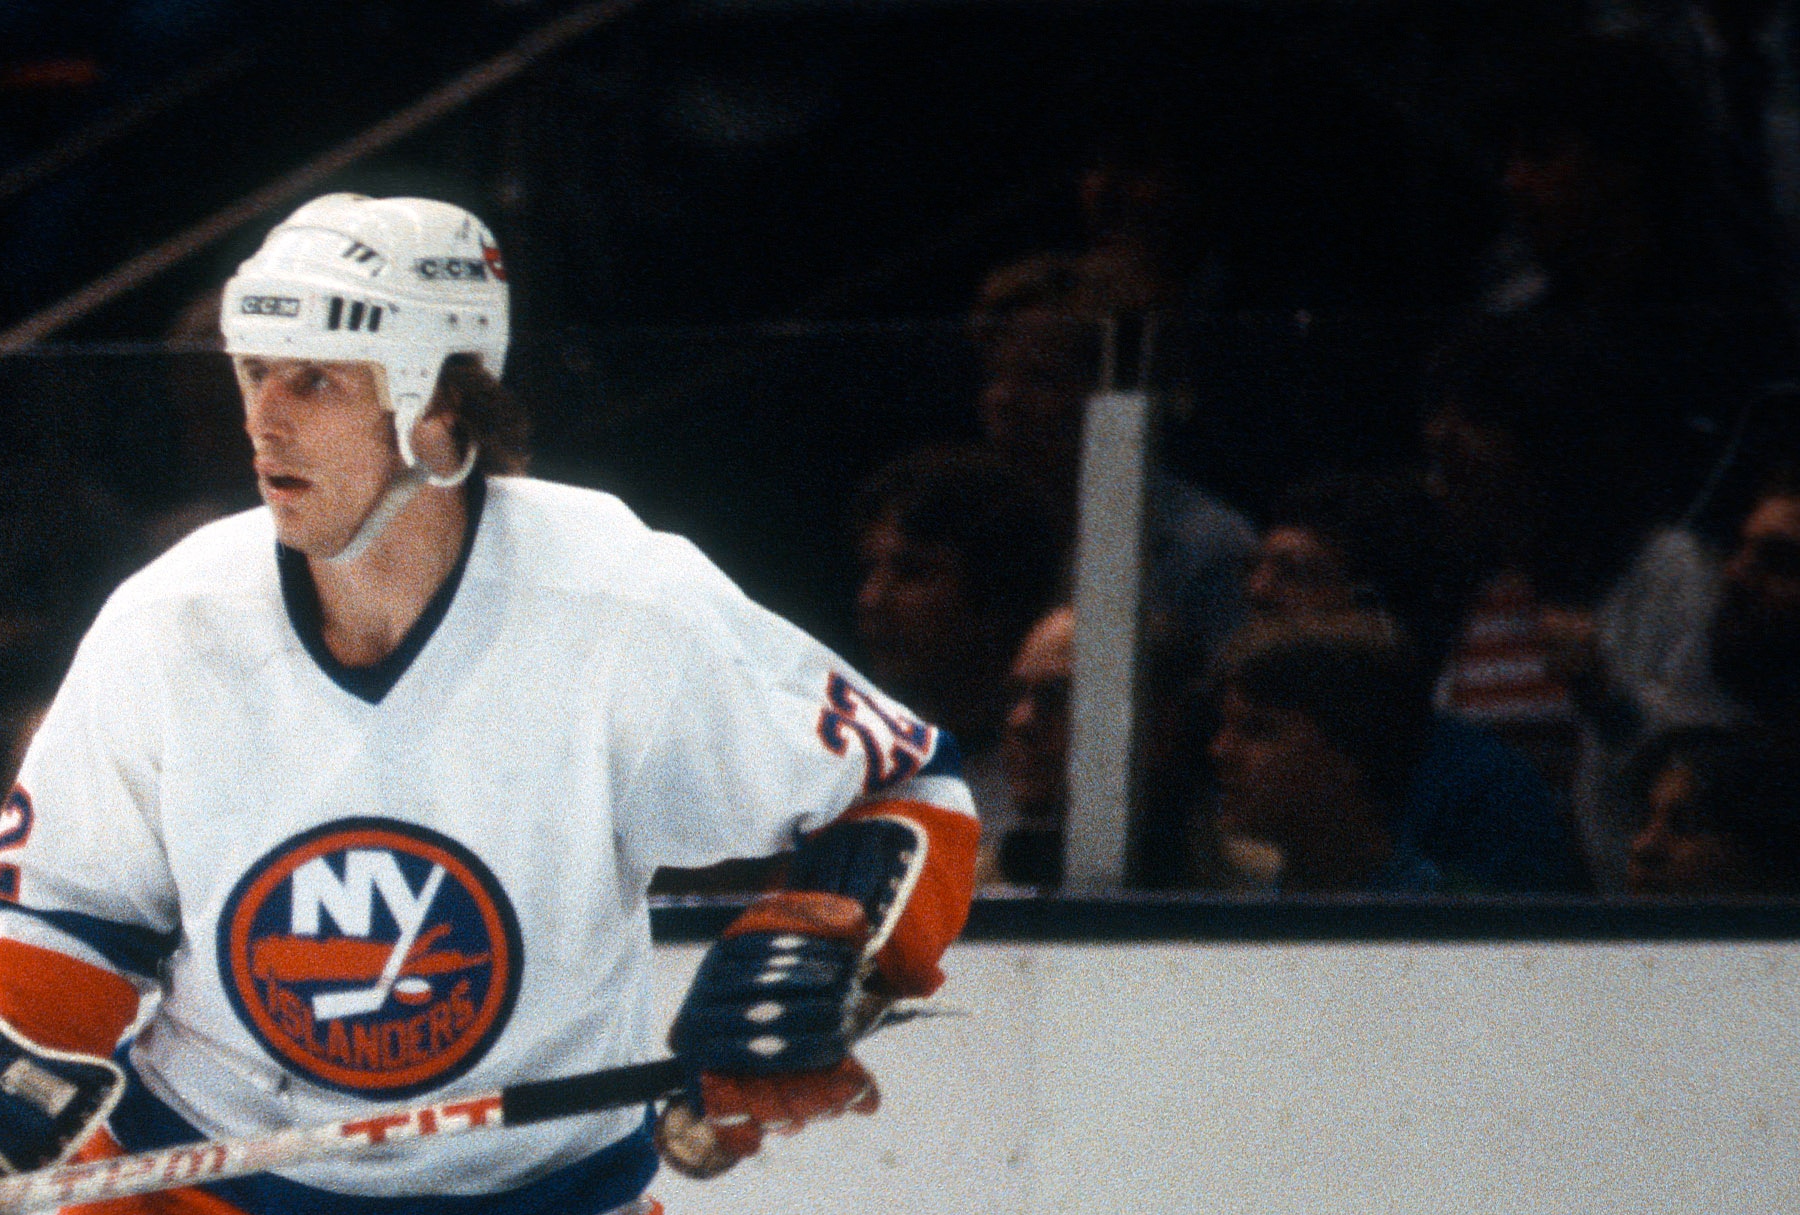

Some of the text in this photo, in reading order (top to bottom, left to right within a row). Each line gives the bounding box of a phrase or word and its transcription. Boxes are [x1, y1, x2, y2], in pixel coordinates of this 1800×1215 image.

[242, 297, 299, 315] CCM
[817, 671, 932, 795] 22
[291, 850, 446, 992] NY
[262, 970, 475, 1068] ISLANDERS
